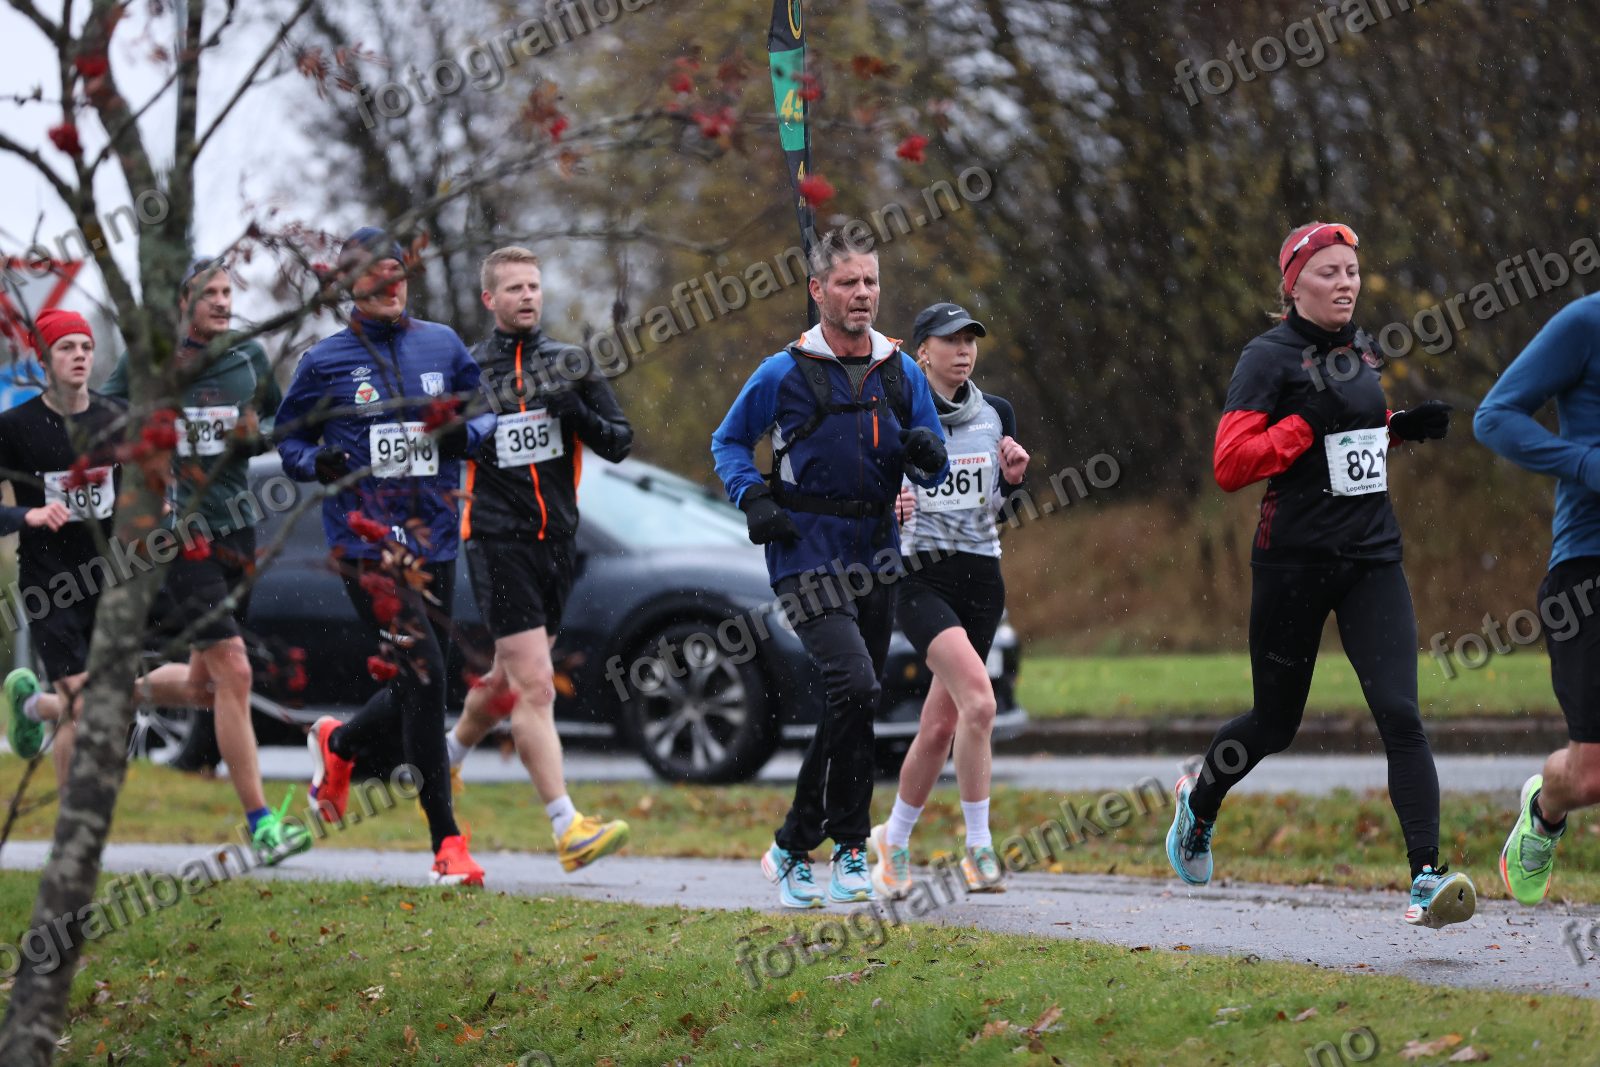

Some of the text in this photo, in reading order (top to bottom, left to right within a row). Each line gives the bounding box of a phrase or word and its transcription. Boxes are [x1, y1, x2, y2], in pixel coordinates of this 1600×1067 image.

[378, 437, 433, 463] 9518
[508, 424, 549, 452] 385
[1347, 448, 1385, 481] 821
